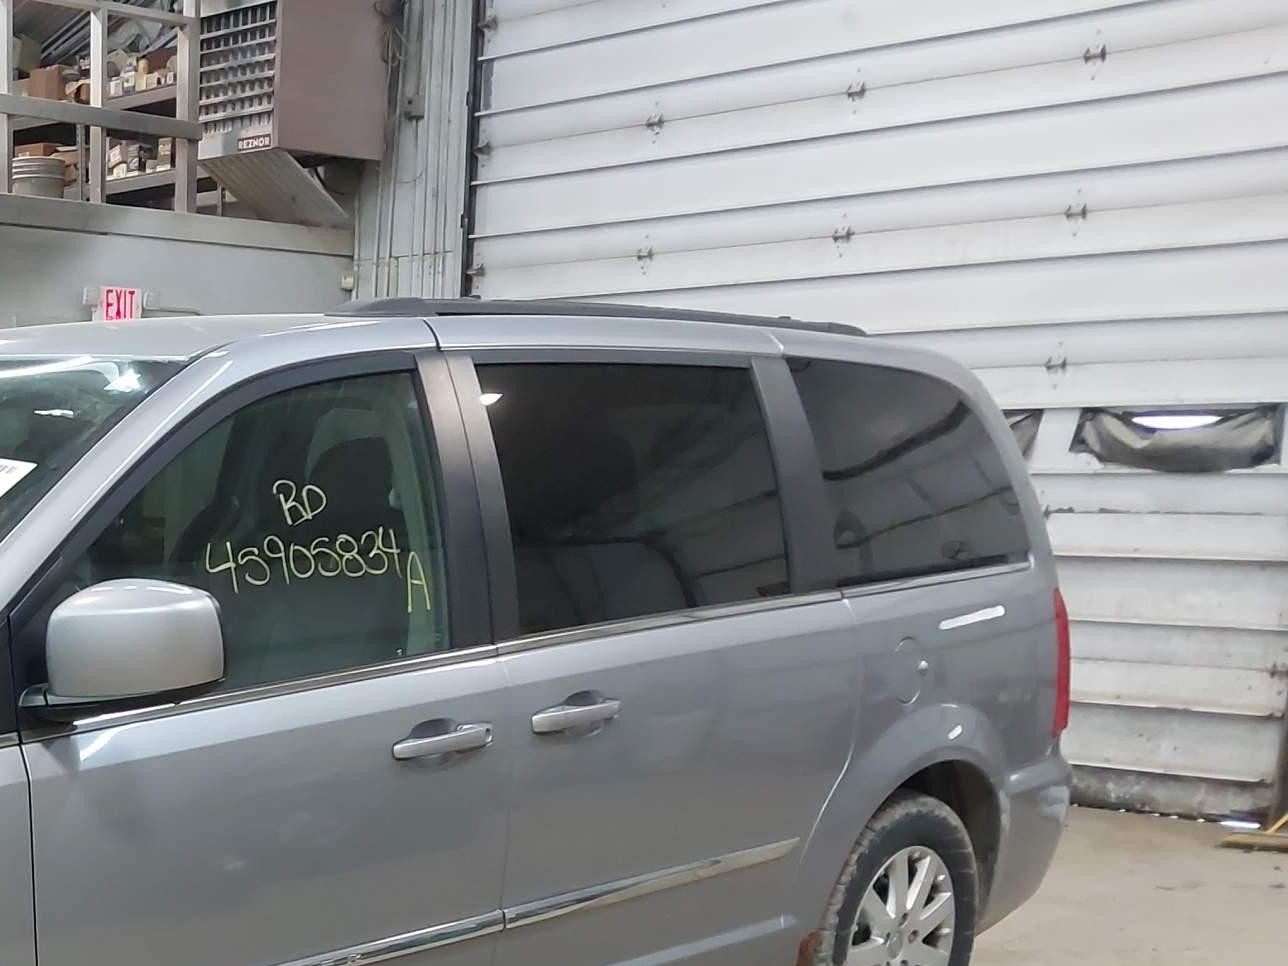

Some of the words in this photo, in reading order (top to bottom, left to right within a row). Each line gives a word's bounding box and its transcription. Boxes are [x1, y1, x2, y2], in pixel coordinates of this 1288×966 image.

[238, 136, 270, 150] REZNOR
[106, 290, 136, 320] EXIT
[205, 526, 402, 594] 45905834
[407, 551, 431, 613] A
